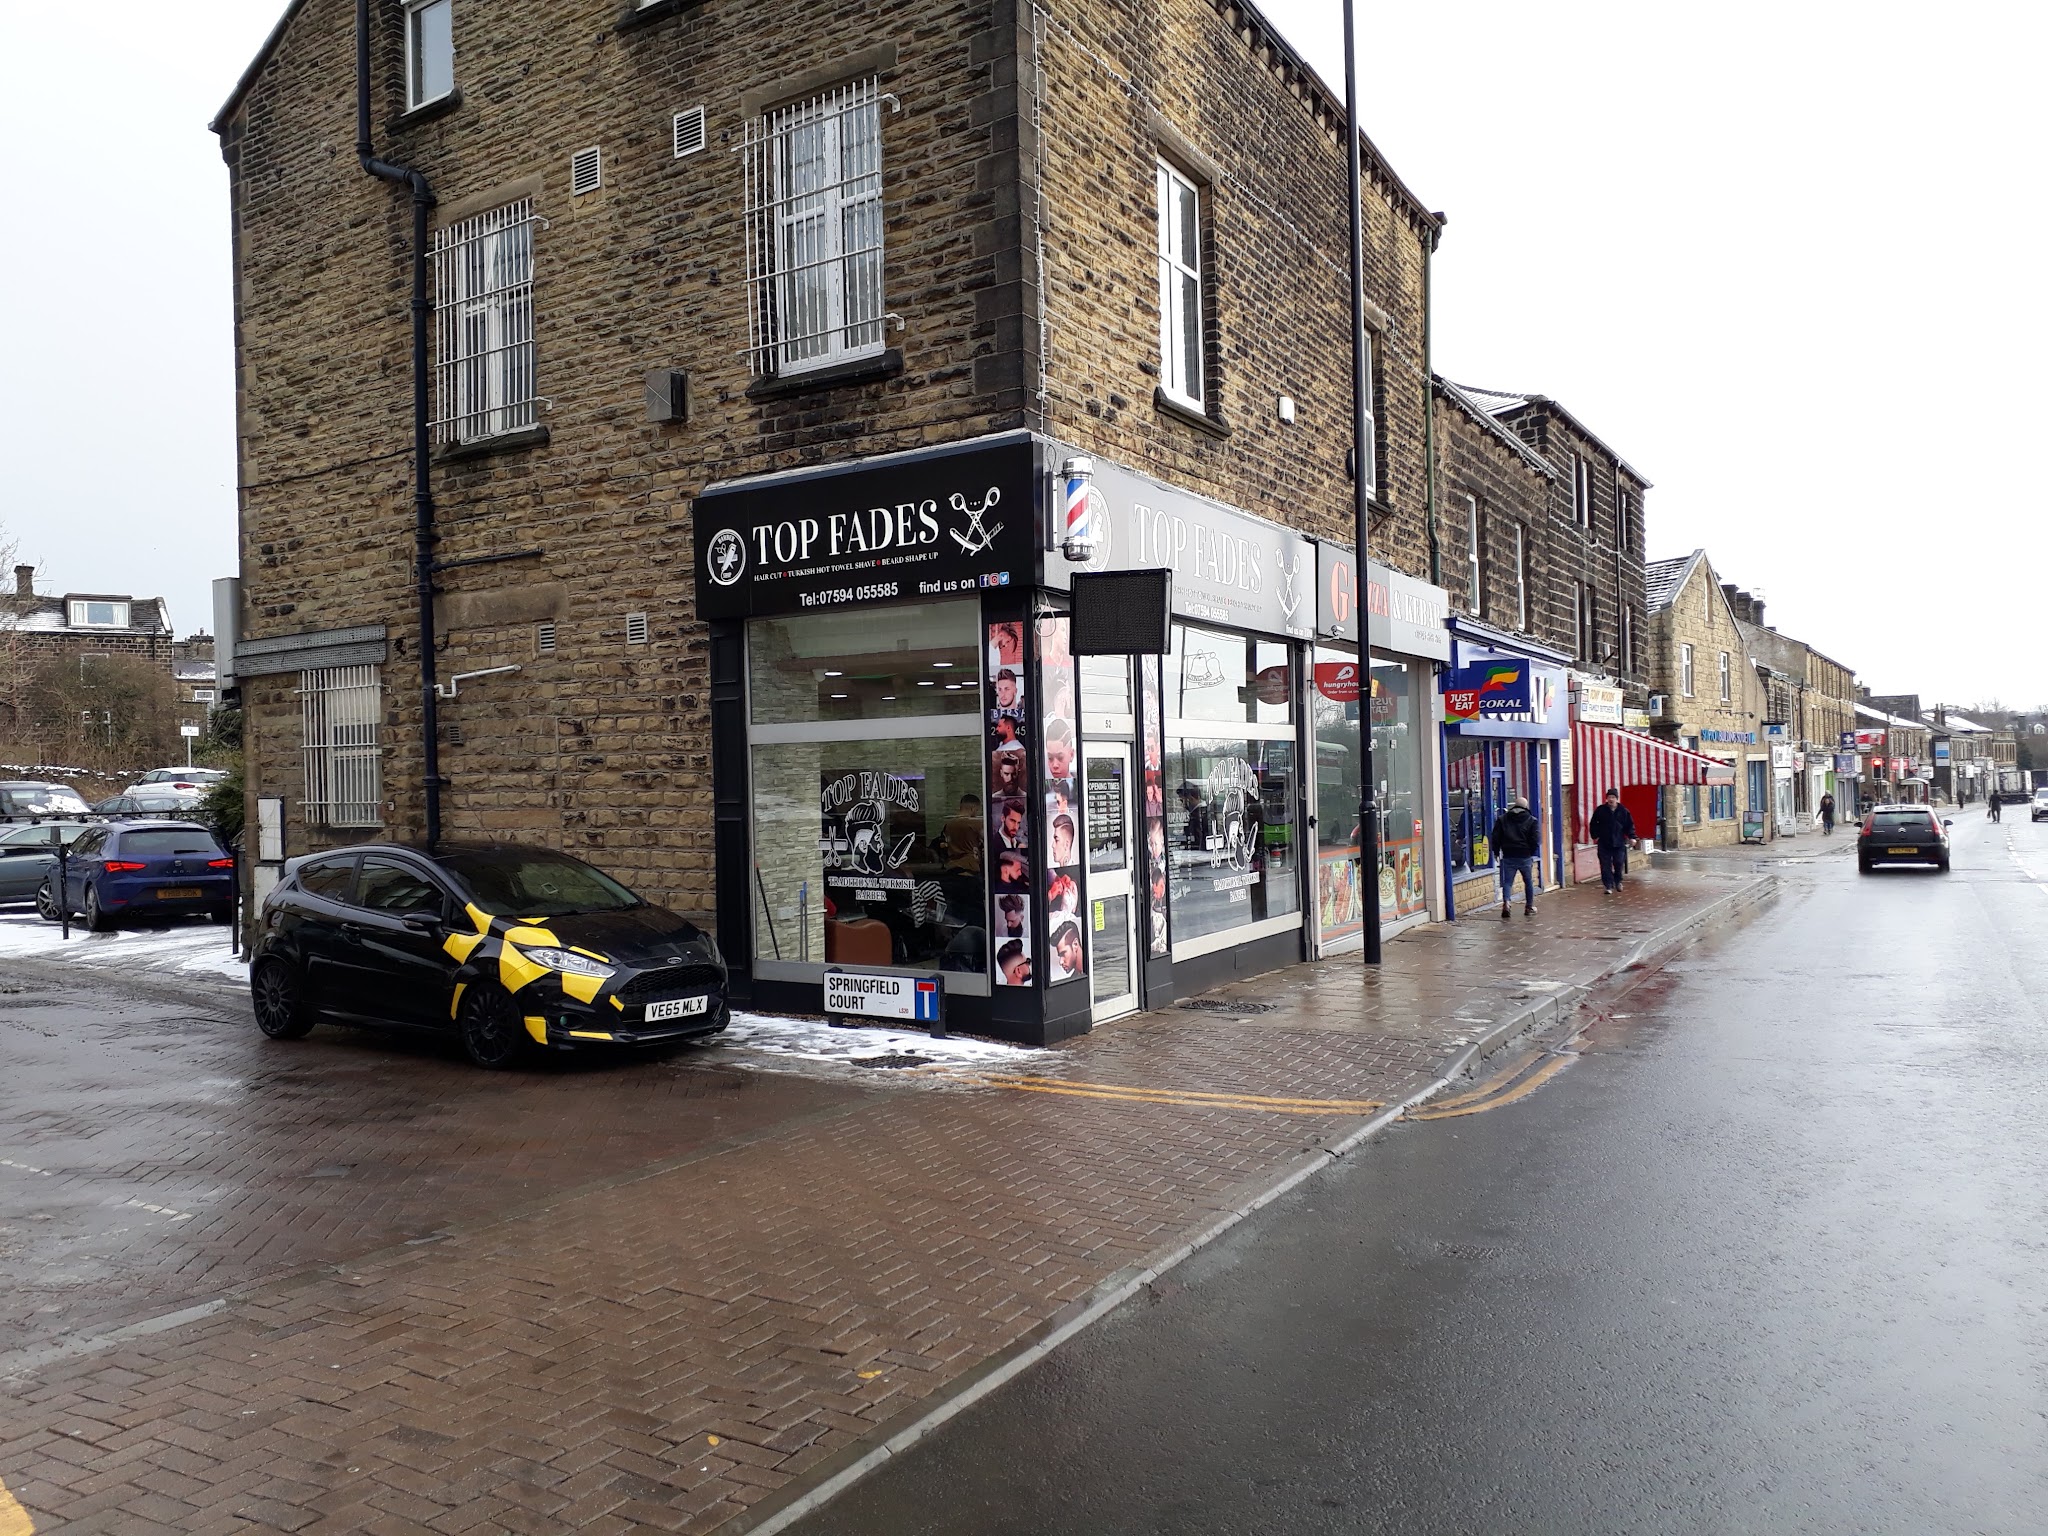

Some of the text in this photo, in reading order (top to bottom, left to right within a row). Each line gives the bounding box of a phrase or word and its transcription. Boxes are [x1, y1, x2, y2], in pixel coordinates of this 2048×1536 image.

[752, 499, 940, 565] TOP FADES
[1134, 502, 1263, 594] TOP FADES
[754, 551, 939, 582] HAIR CUT TURKISH HOT TOWEL SHAVE BEARD SHAPE UP
[799, 581, 899, 607] Tel:07594 055585
[919, 578, 975, 594] find us on
[1330, 560, 1350, 622] G
[1392, 589, 1401, 620] &
[1404, 593, 1441, 630] KEBAB
[1449, 692, 1474, 704] JUST
[1455, 701, 1474, 711] EAT
[1479, 698, 1523, 709] CORAL
[1105, 719, 1112, 729] 52
[821, 771, 920, 813] TOP FADES
[1088, 782, 1120, 791] OPENING TIMES
[828, 876, 916, 890] TRADITIONAL TURKISH
[855, 889, 887, 902] BARBER
[828, 976, 900, 996] SPRINGFIELD
[651, 997, 704, 1018] VE65 MLX
[829, 994, 866, 1010] COURT
